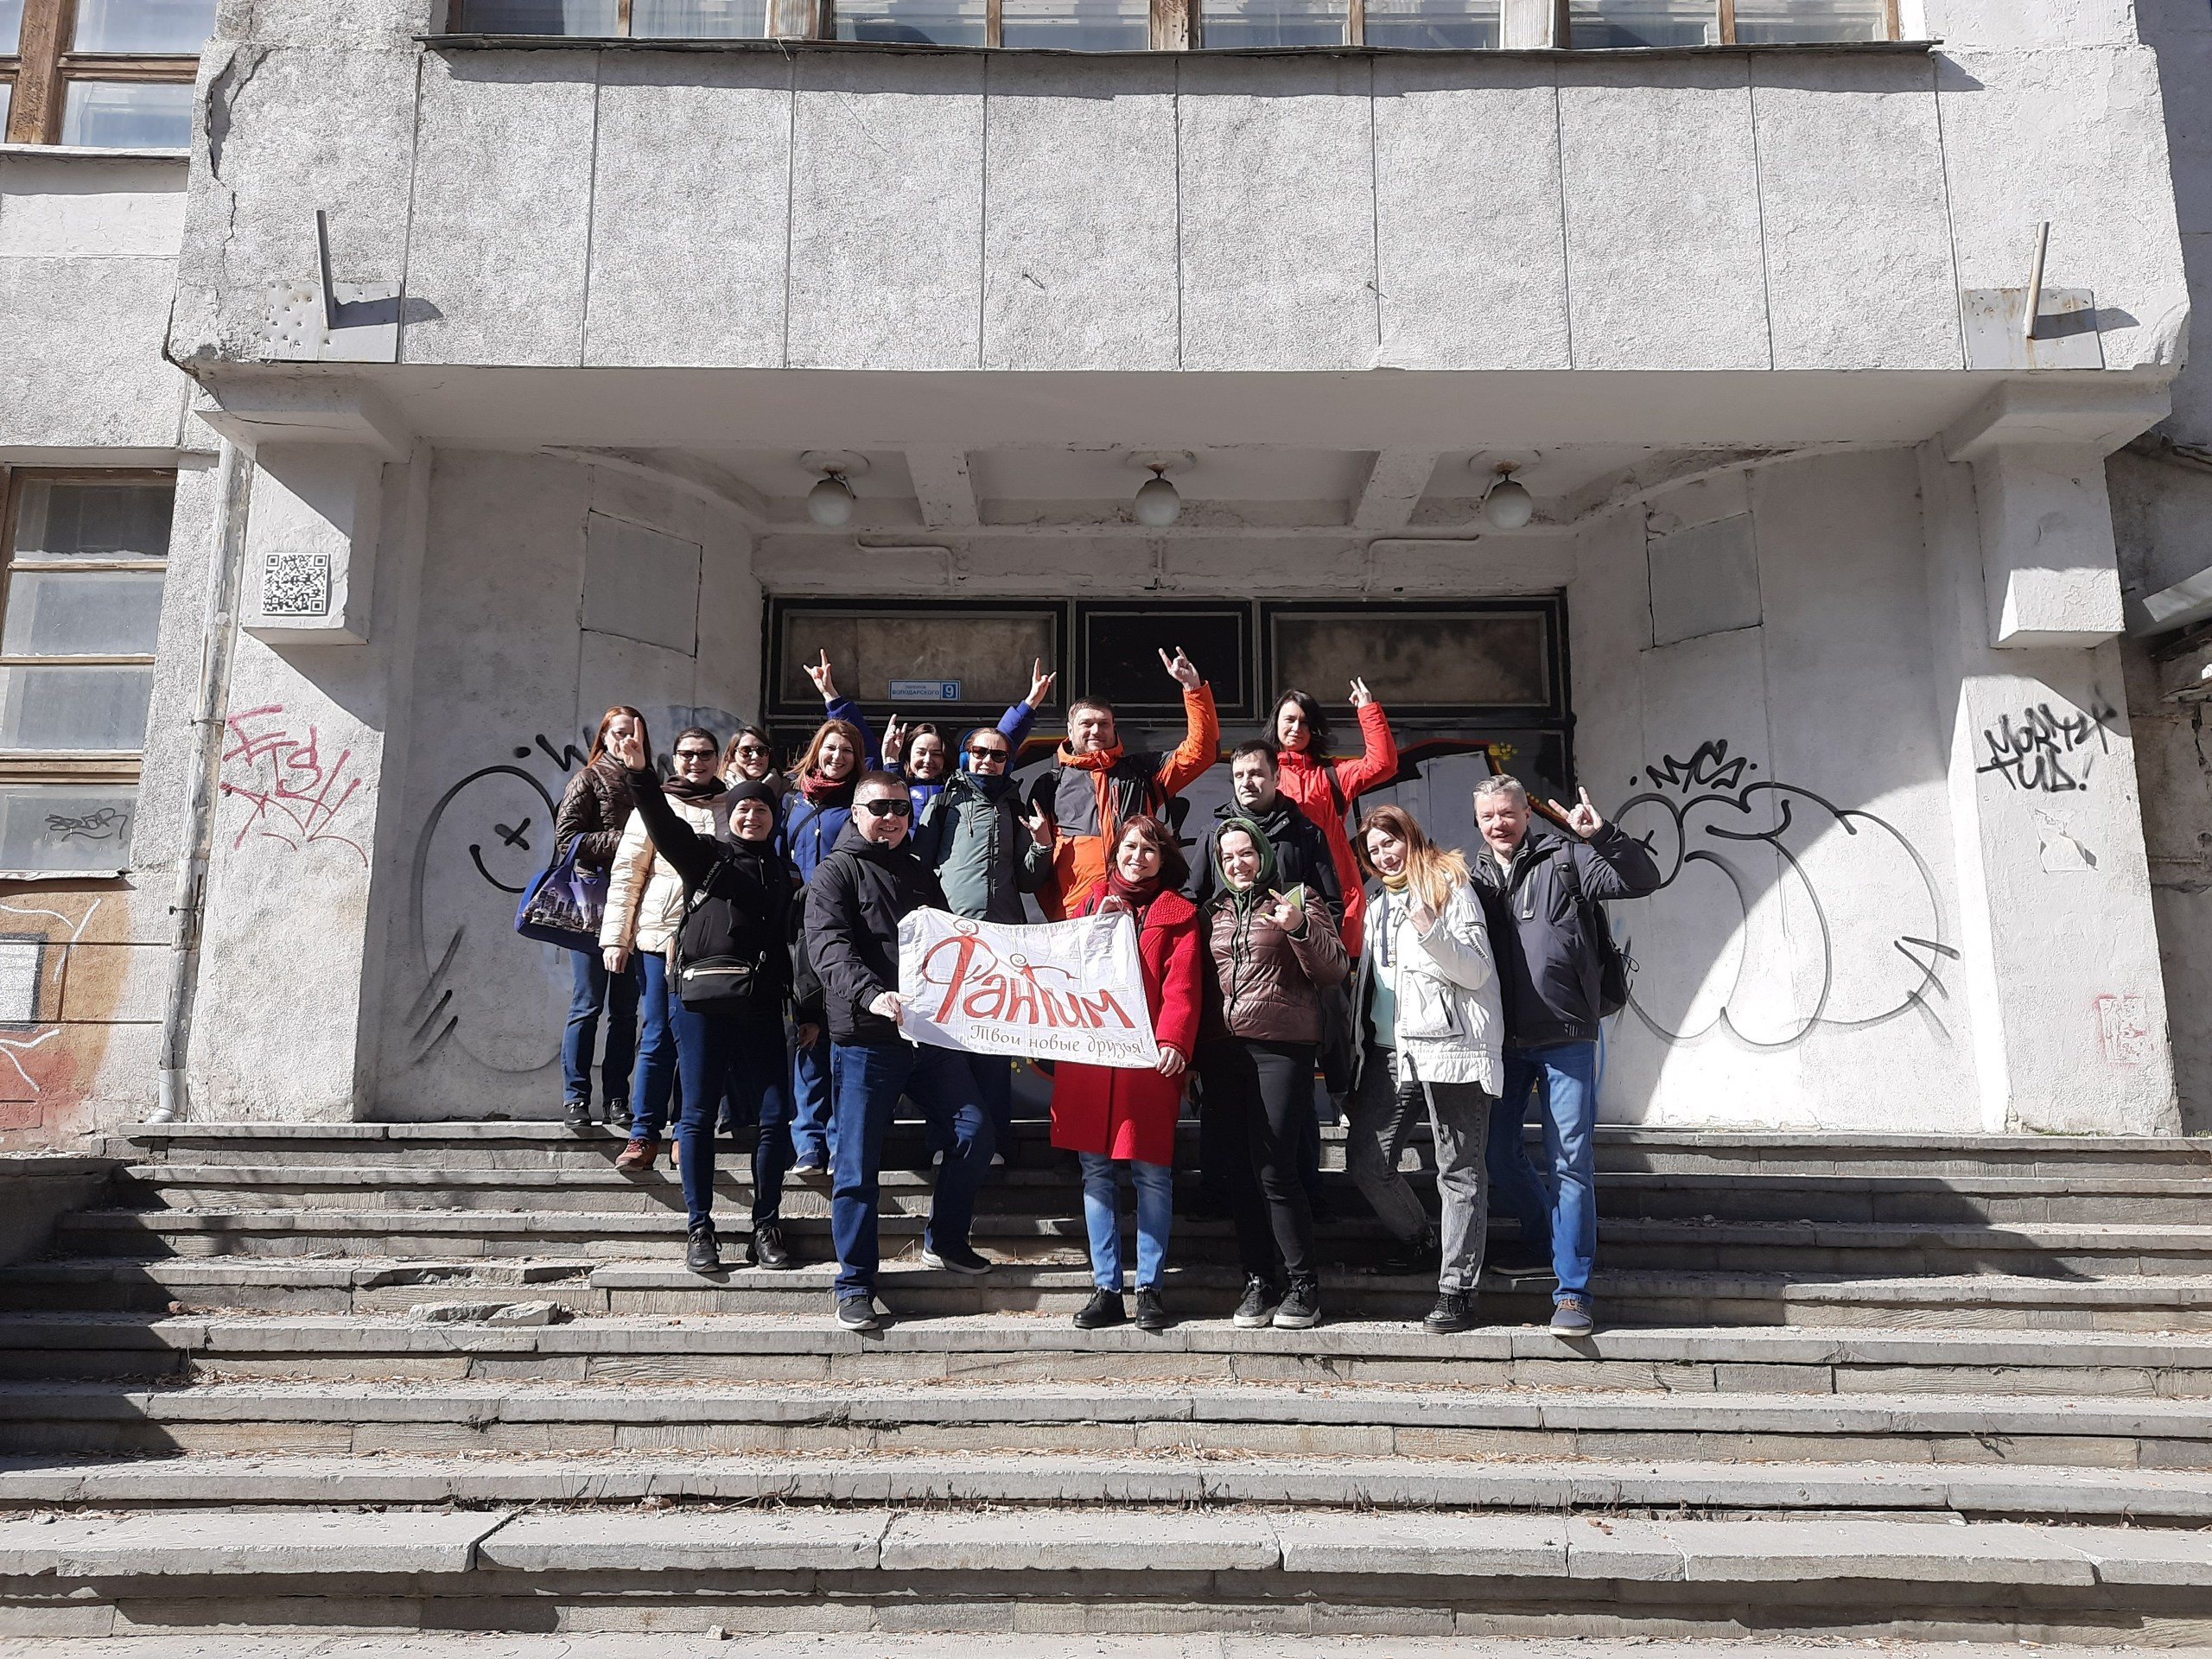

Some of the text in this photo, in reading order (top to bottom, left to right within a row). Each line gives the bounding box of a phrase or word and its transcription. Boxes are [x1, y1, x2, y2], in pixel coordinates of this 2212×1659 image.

[944, 684, 955, 698] 9
[921, 935, 1137, 1029] Фантим
[969, 1024, 1147, 1059] Твои новые друзья!
